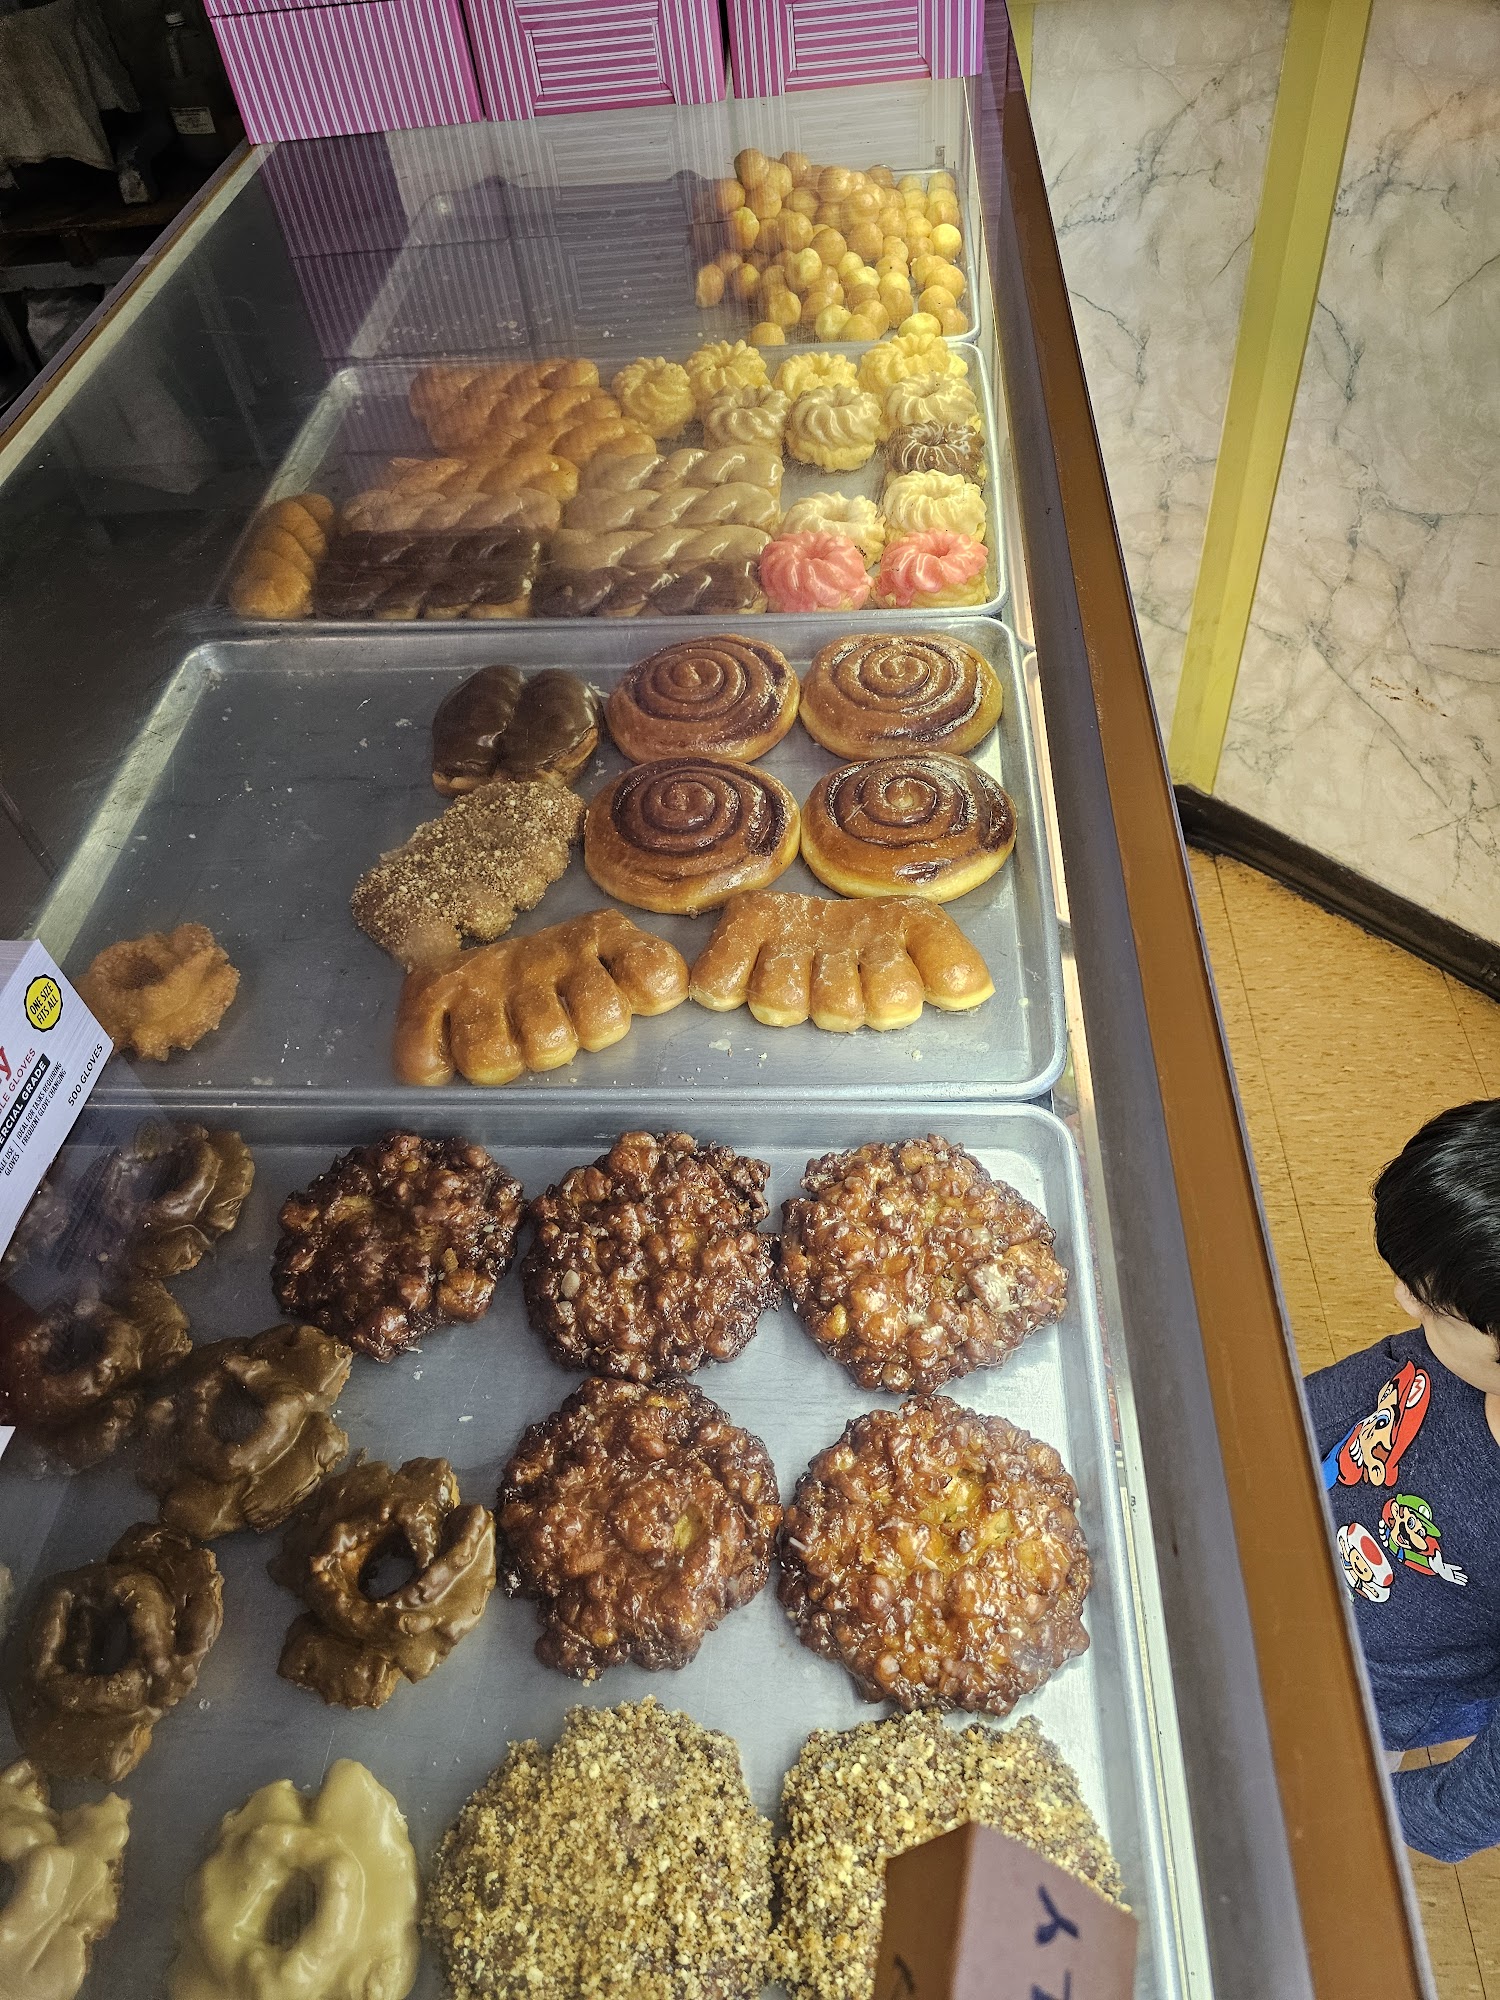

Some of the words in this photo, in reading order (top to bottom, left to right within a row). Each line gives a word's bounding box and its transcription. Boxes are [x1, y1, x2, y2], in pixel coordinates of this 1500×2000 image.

[30, 996, 43, 1015] ONE
[40, 981, 54, 1001] SIZE
[36, 1005, 50, 1025] FITS
[47, 994, 59, 1011] ALL
[8, 1047, 36, 1092] GLOVES
[21, 1060, 46, 1101] GRADE
[67, 1084, 82, 1107] 500
[80, 1043, 103, 1084] GLOVES
[16, 1121, 29, 1140] IDEAL
[25, 1108, 36, 1123] FOR
[32, 1091, 45, 1111] TASKS
[42, 1061, 62, 1093] REQUIRING
[21, 1115, 40, 1146] FREQUENT
[37, 1097, 51, 1117] GLOVE
[48, 1068, 67, 1099] CHANGING
[4, 1145, 14, 1160] USE
[4, 1152, 20, 1176] GLOVES
